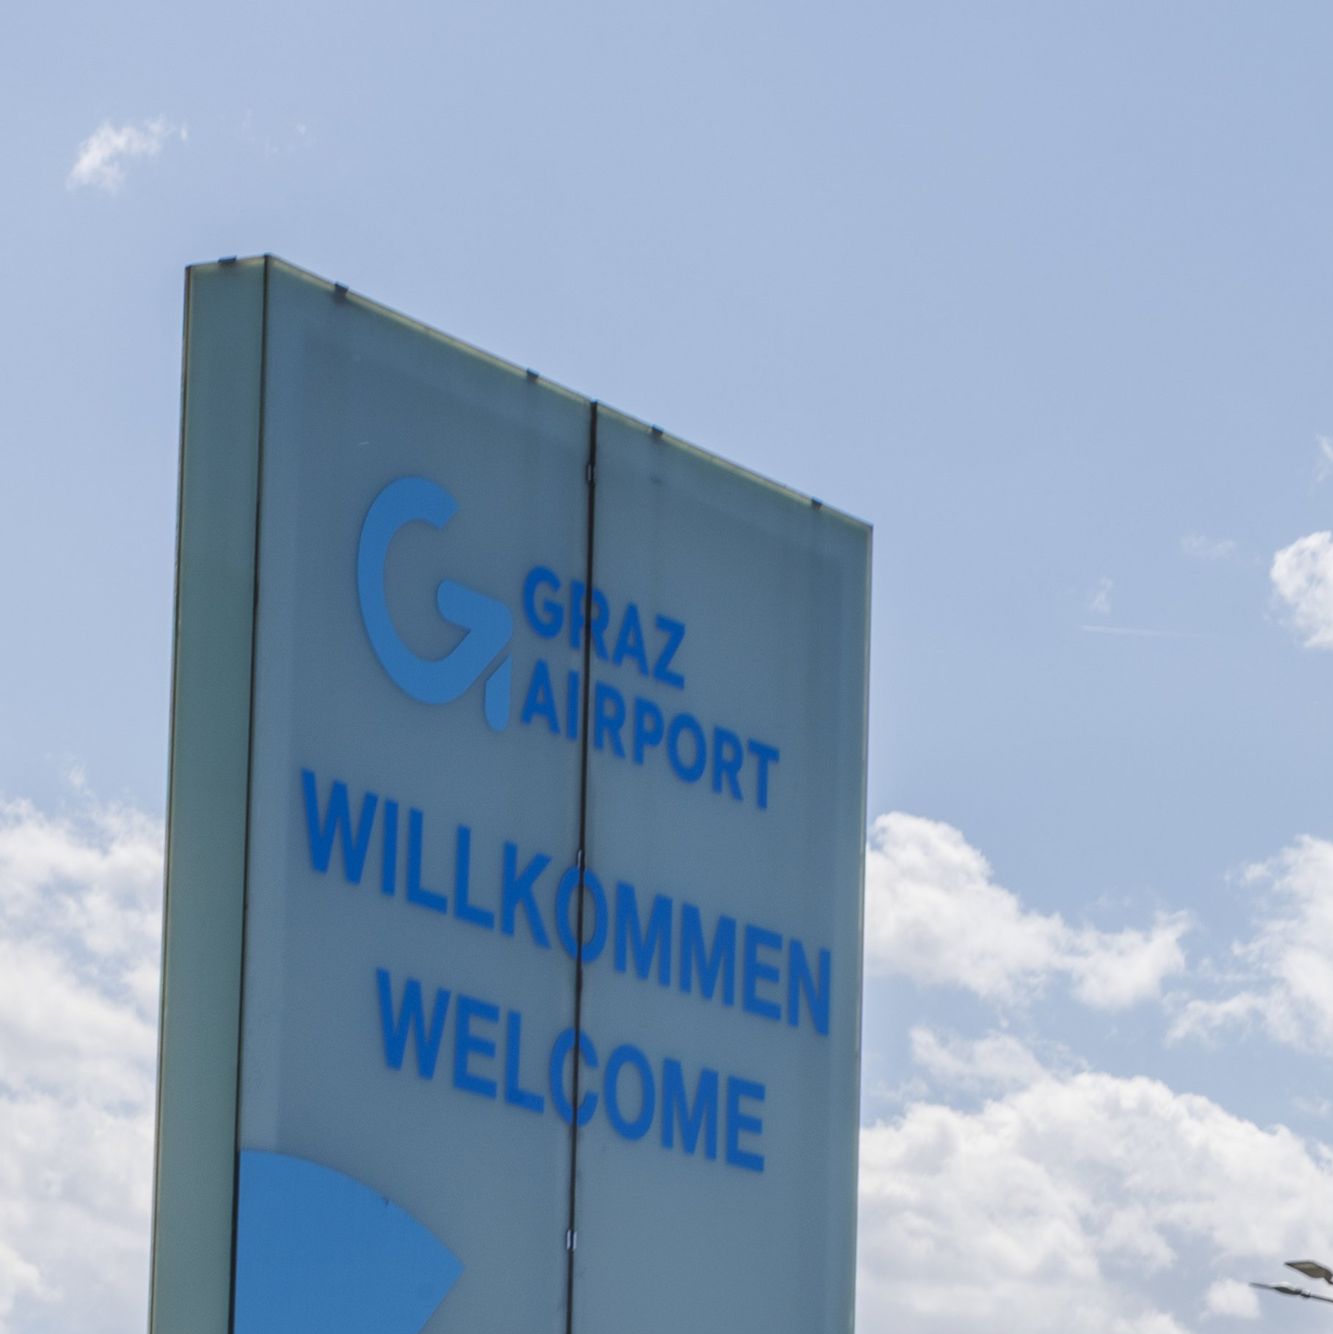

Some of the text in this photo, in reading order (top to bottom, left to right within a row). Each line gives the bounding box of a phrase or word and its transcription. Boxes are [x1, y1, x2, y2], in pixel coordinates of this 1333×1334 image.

[521, 565, 687, 690] GRAZ
[520, 660, 781, 811] AIRPORT
[300, 768, 832, 1037] WILLKOMMEN
[375, 967, 767, 1174] WELCOME
